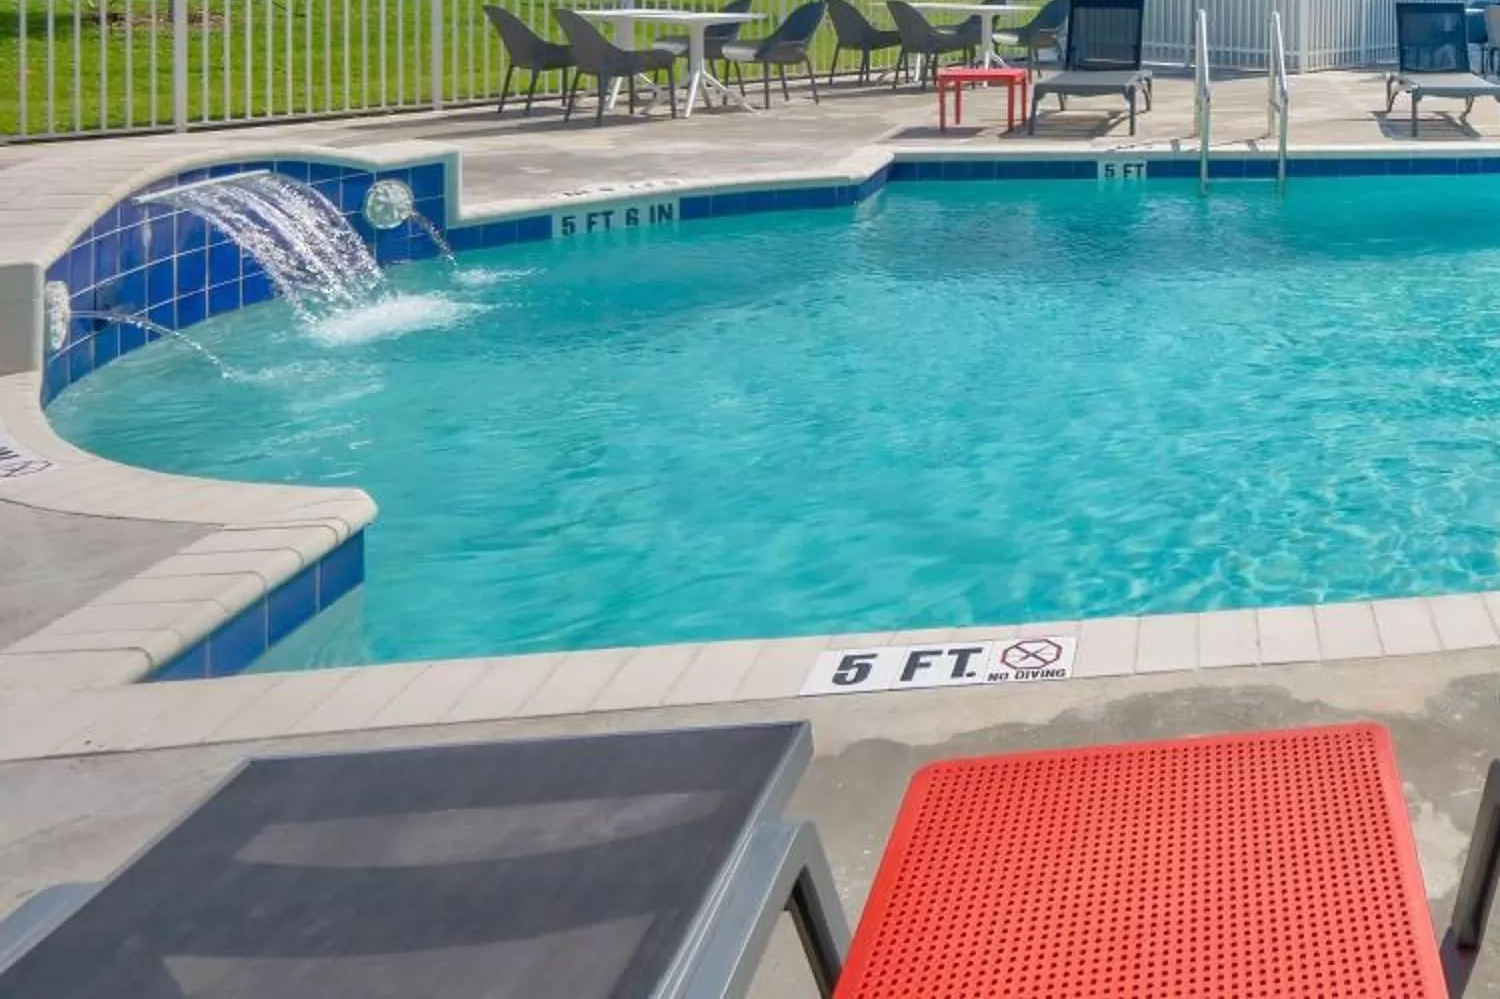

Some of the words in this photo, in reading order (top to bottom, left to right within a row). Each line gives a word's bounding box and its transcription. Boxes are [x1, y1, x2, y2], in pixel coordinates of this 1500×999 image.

[1123, 163, 1144, 178] FT
[561, 215, 576, 236] 5
[587, 210, 614, 233] FT
[625, 207, 639, 226] 6
[649, 203, 673, 225] IN
[831, 653, 878, 686] 5
[899, 647, 983, 682] FT.
[987, 672, 1010, 682] NO
[1014, 668, 1067, 680] DIVING
